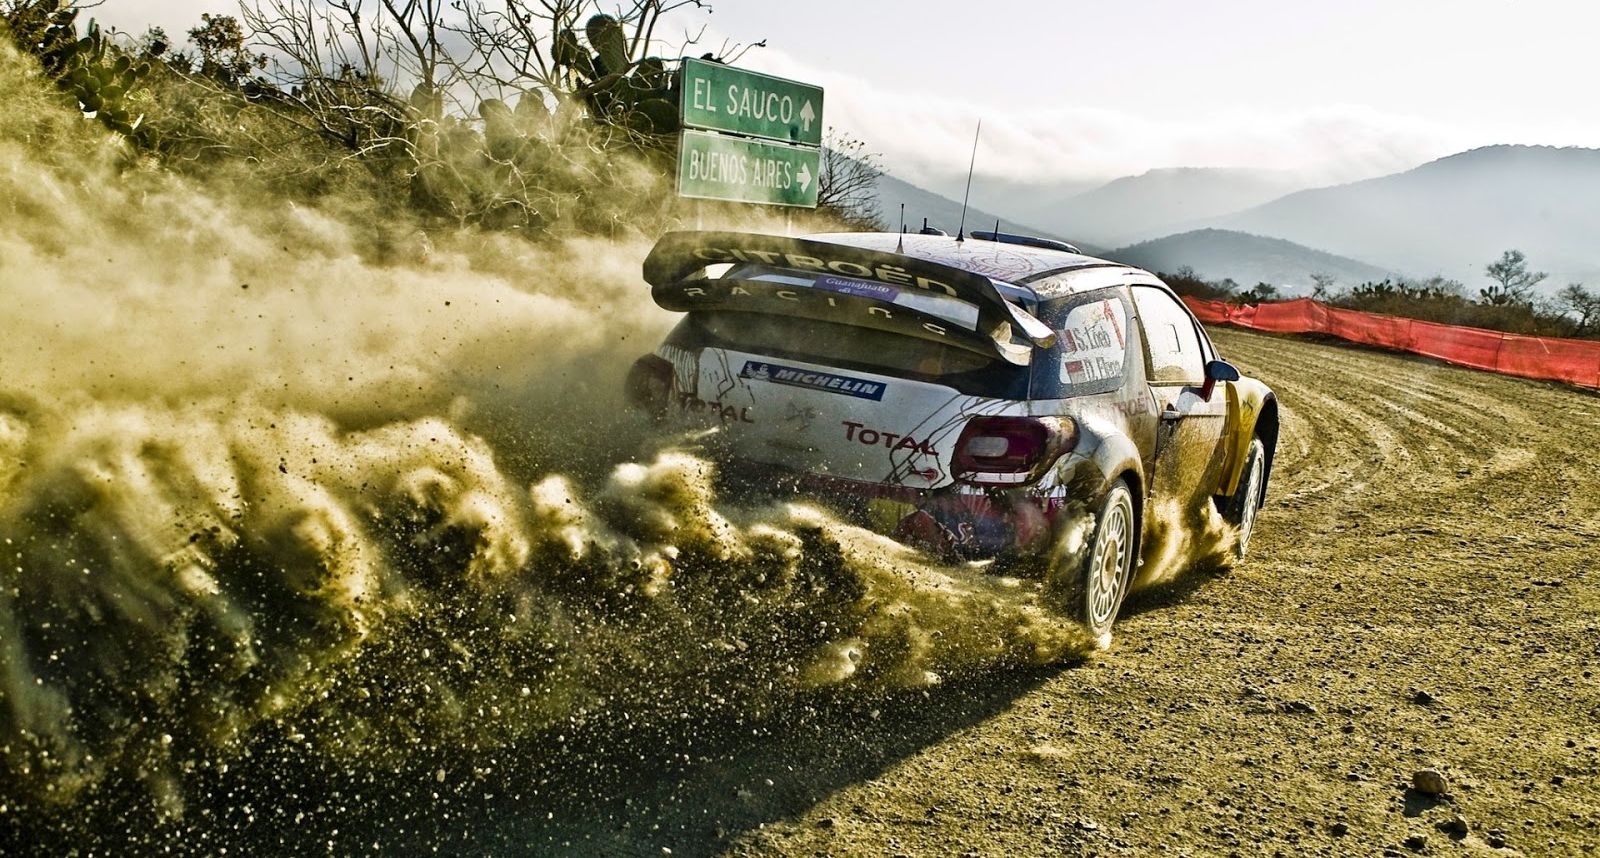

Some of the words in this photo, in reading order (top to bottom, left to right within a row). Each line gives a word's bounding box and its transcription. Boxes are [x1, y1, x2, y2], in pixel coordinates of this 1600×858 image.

[693, 77, 717, 112] EL
[726, 84, 793, 124] SAUCO
[689, 149, 748, 185] BUENOS
[752, 157, 792, 189] AIRES
[825, 277, 890, 293] Guanajuato
[683, 286, 947, 337] RACING
[775, 368, 880, 395] MICHELIN
[841, 420, 940, 455] TOTAL
